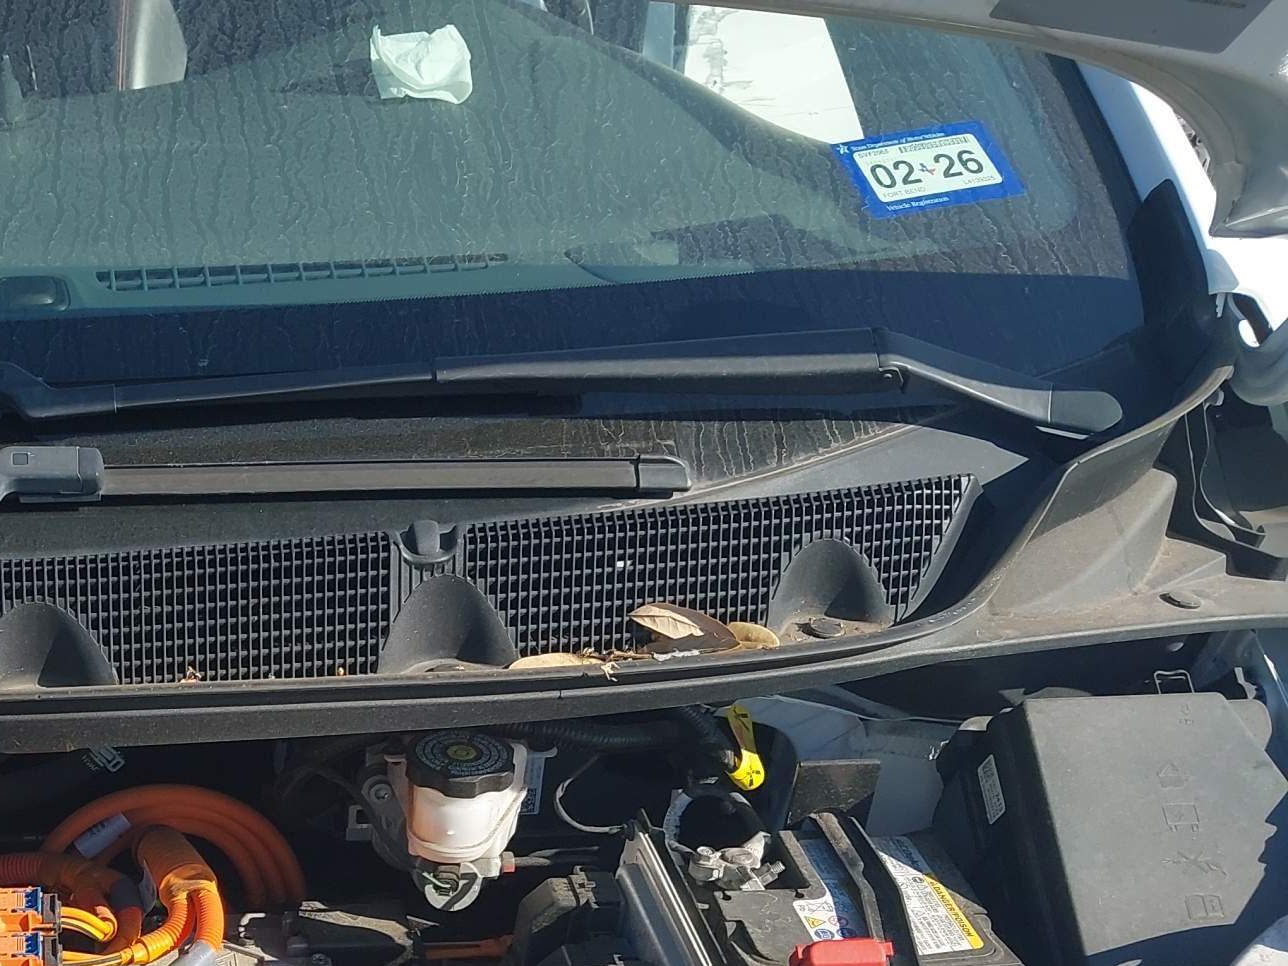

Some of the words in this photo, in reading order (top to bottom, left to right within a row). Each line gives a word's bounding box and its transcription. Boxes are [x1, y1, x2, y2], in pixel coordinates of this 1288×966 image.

[870, 160, 922, 189] 02
[934, 150, 984, 178] 26
[934, 885, 974, 937] DANGER/POISON
